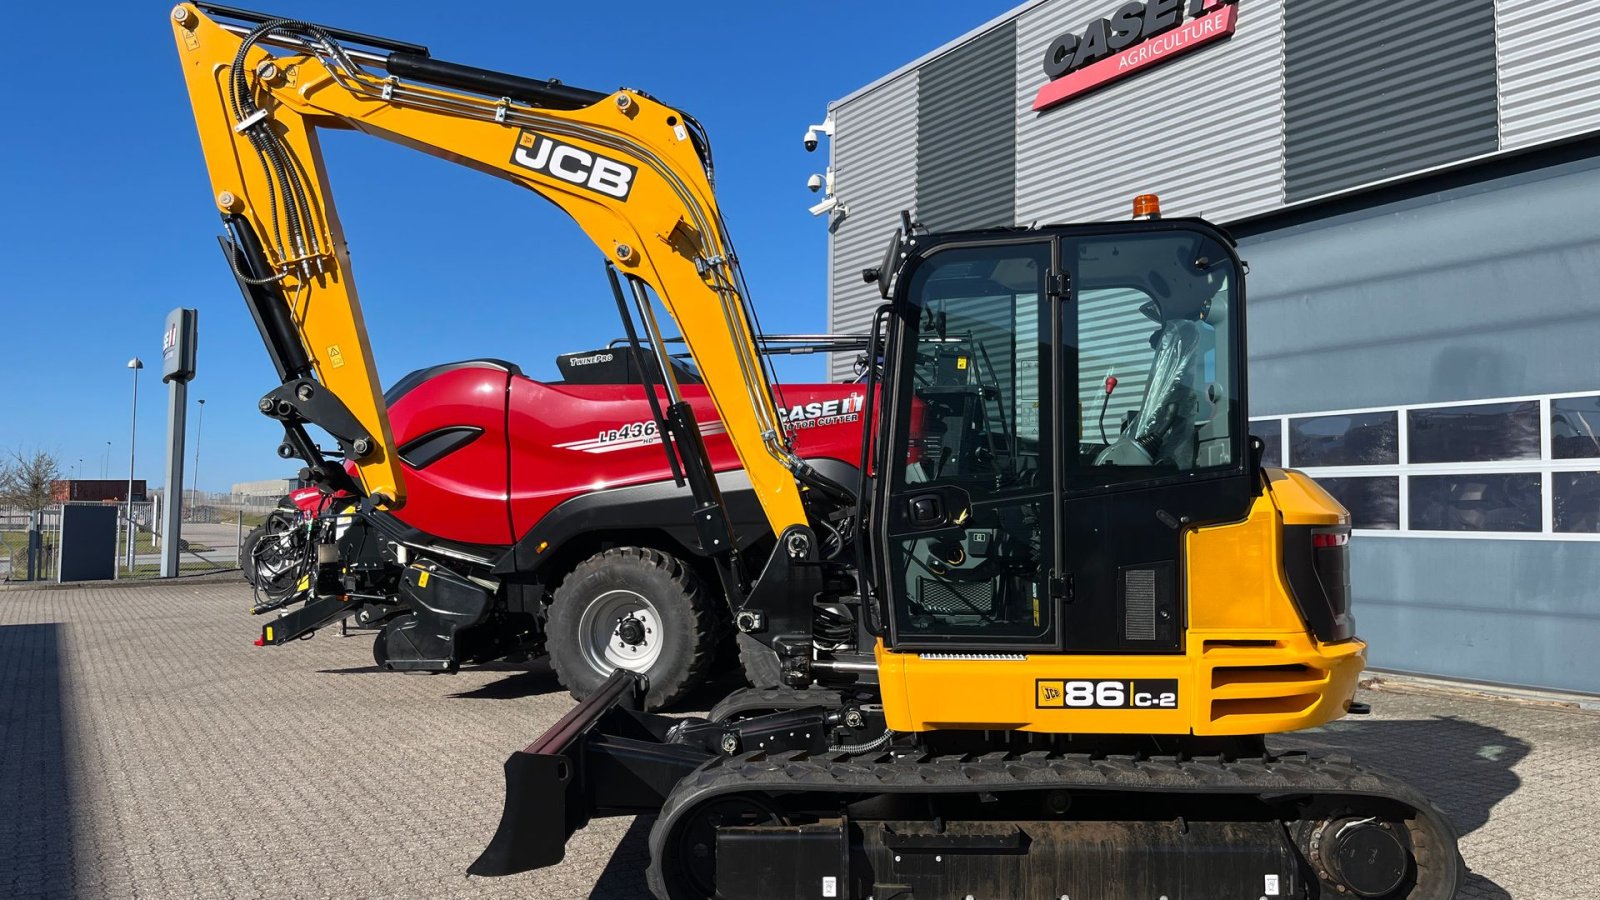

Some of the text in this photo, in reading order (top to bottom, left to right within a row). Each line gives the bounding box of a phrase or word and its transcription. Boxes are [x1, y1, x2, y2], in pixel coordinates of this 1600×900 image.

[1043, 0, 1179, 77] CASE
[1118, 14, 1223, 70] AGRICULTURE
[515, 138, 633, 198] JCB
[818, 414, 859, 426] CUTTER
[1043, 687, 1060, 700] JCB
[1065, 681, 1176, 707] 86 C-2
